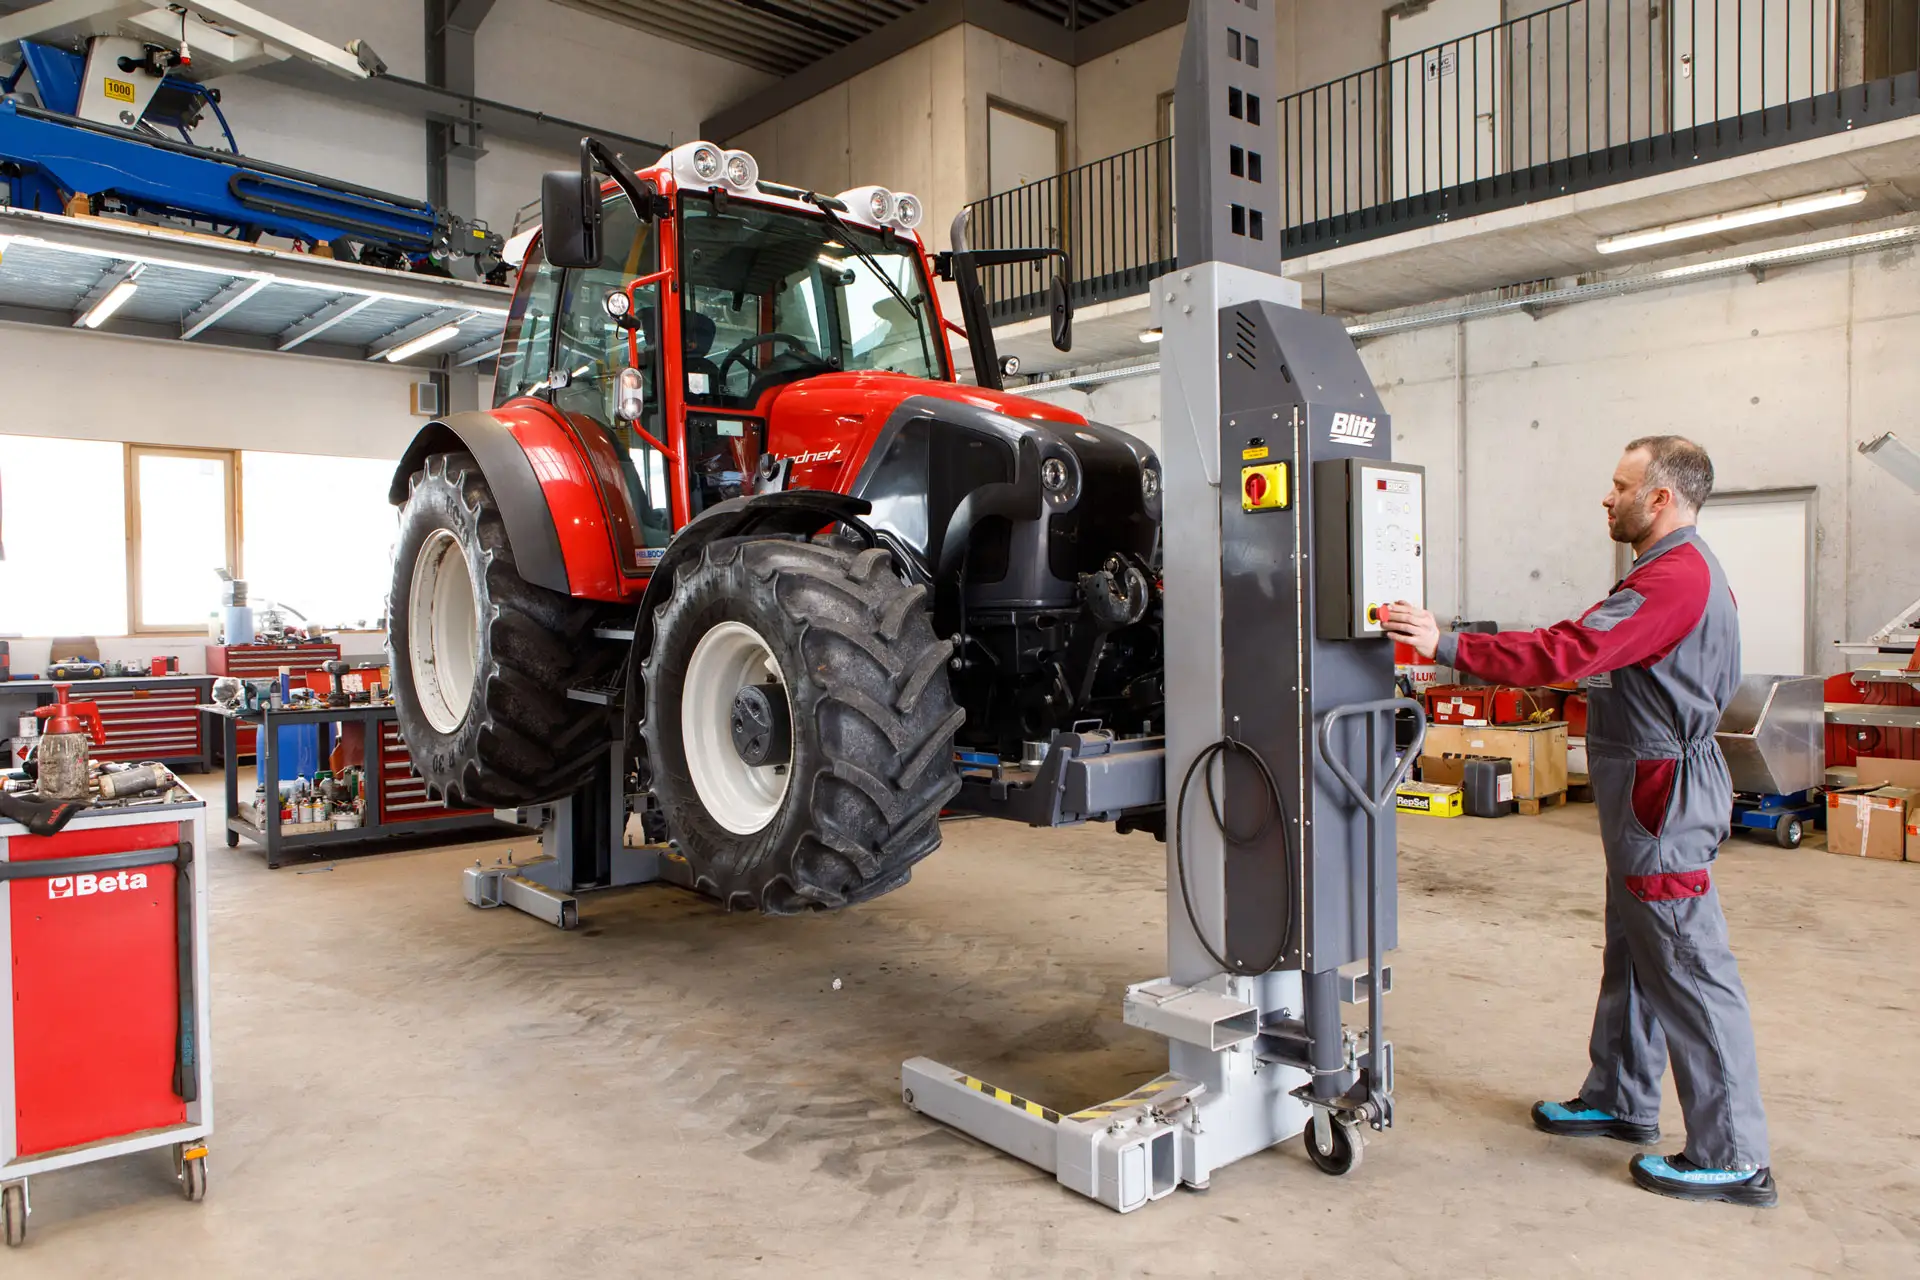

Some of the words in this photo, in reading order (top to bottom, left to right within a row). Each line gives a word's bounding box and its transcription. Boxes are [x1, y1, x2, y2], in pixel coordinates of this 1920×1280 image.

[108, 82, 131, 96] 1000
[1330, 412, 1377, 439] Blitz
[774, 443, 842, 465] Ldner
[432, 754, 445, 773] 30
[1396, 796, 1429, 809] RepSet
[76, 871, 148, 896] Beta
